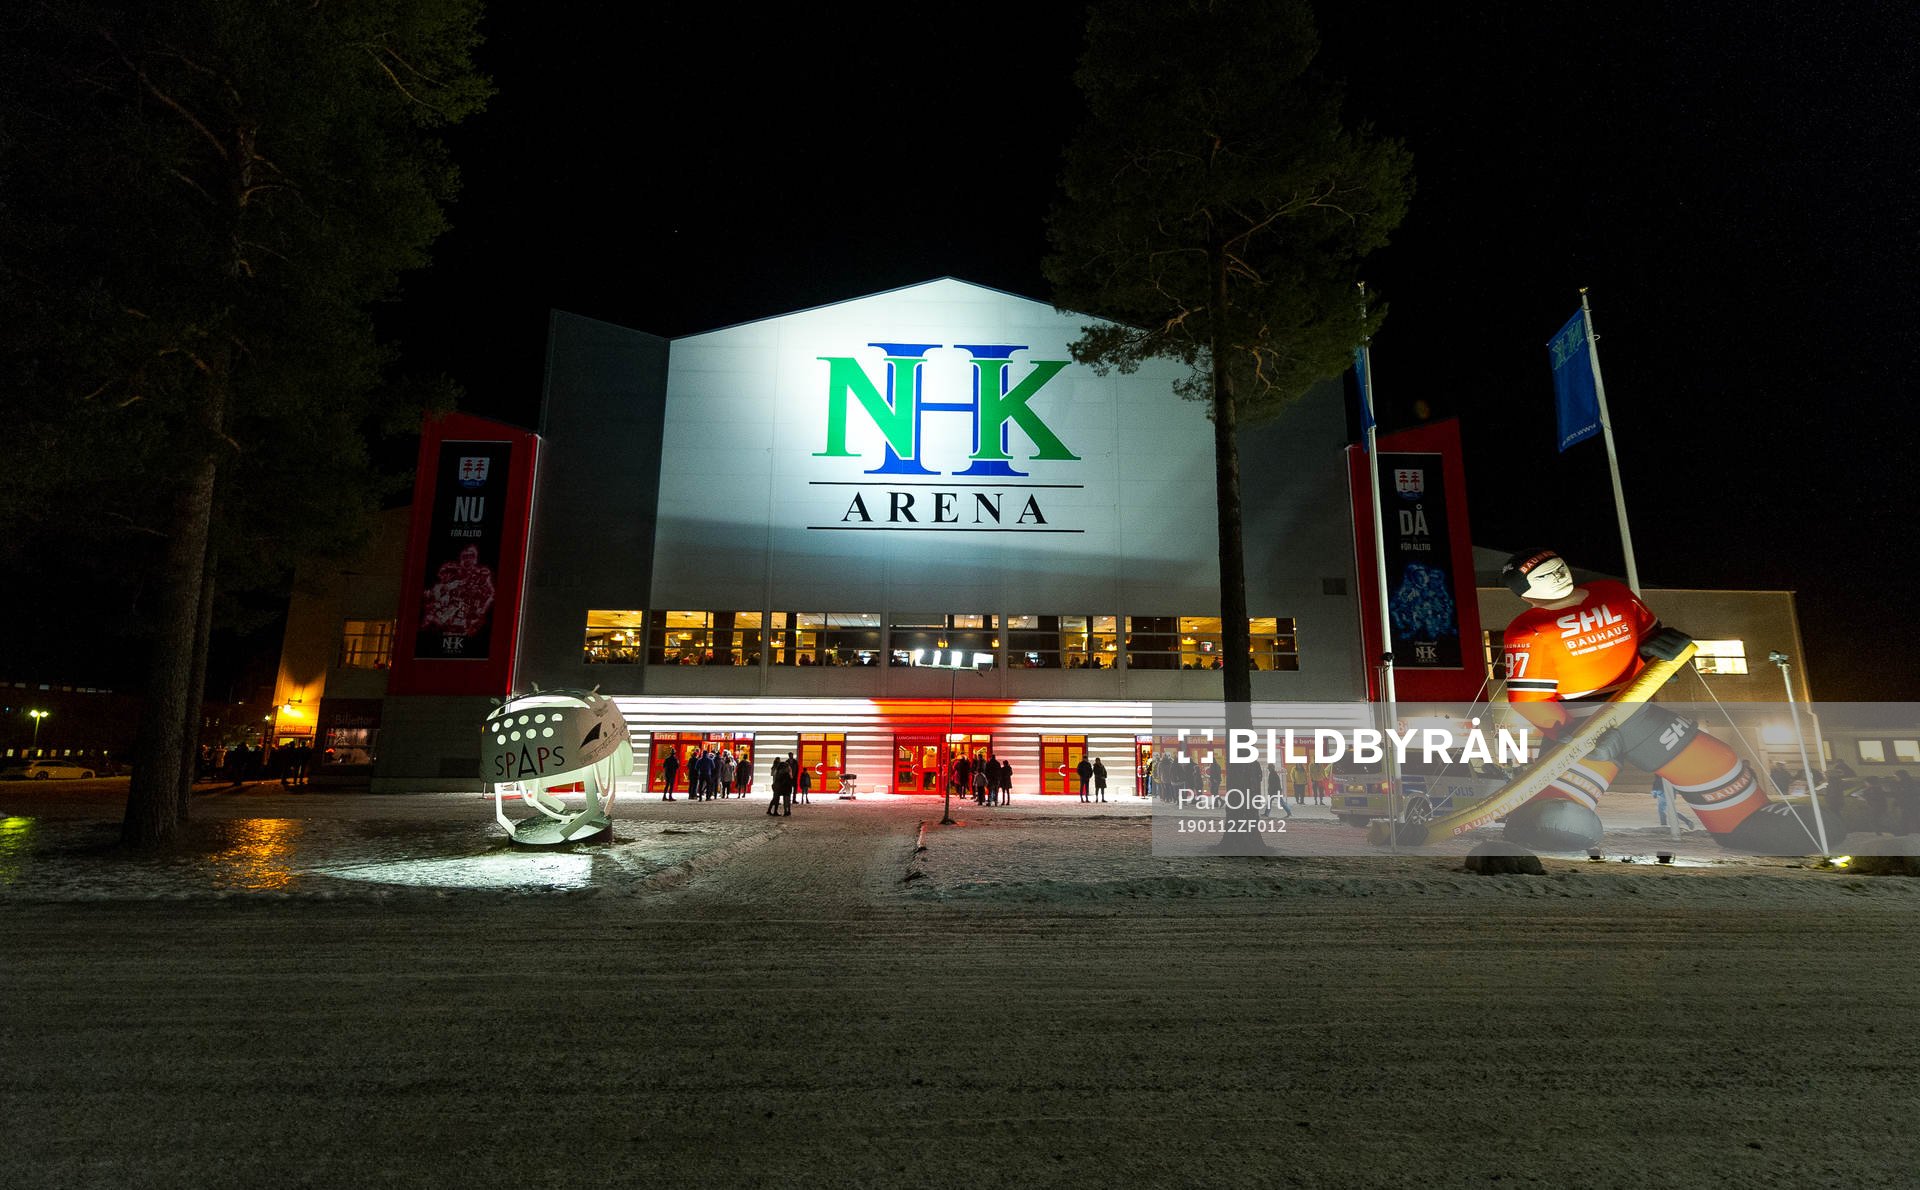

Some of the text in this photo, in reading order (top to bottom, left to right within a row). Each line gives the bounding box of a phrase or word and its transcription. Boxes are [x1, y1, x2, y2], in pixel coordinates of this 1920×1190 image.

[812, 343, 1082, 476] NHK
[454, 496, 485, 523] NU
[841, 491, 1048, 525] ARENA
[1399, 504, 1430, 536] DÅ
[1556, 604, 1622, 638] SHL
[1566, 624, 1629, 650] BAUHAUS
[494, 743, 565, 779] SPAPS
[1448, 785, 1474, 797] POLIS
